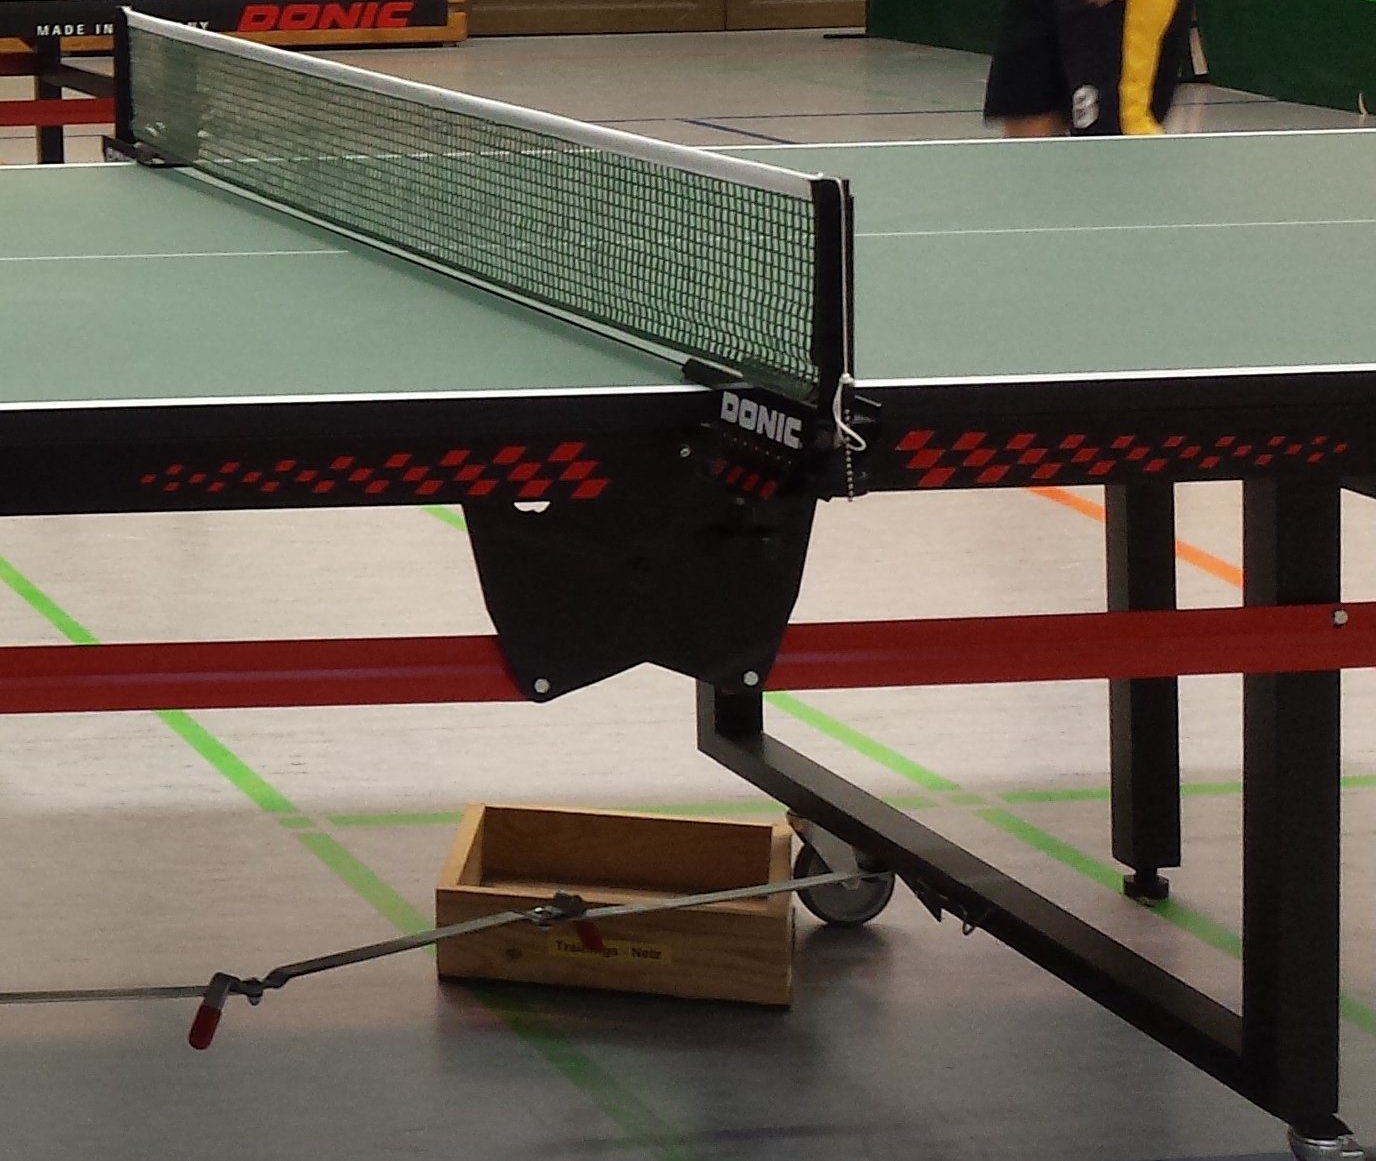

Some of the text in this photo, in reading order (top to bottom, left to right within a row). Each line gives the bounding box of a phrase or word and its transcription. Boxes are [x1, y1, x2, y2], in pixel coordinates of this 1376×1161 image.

[36, 23, 114, 36] MADE IN
[239, 0, 416, 31] DONIC
[720, 391, 803, 449] DONIC
